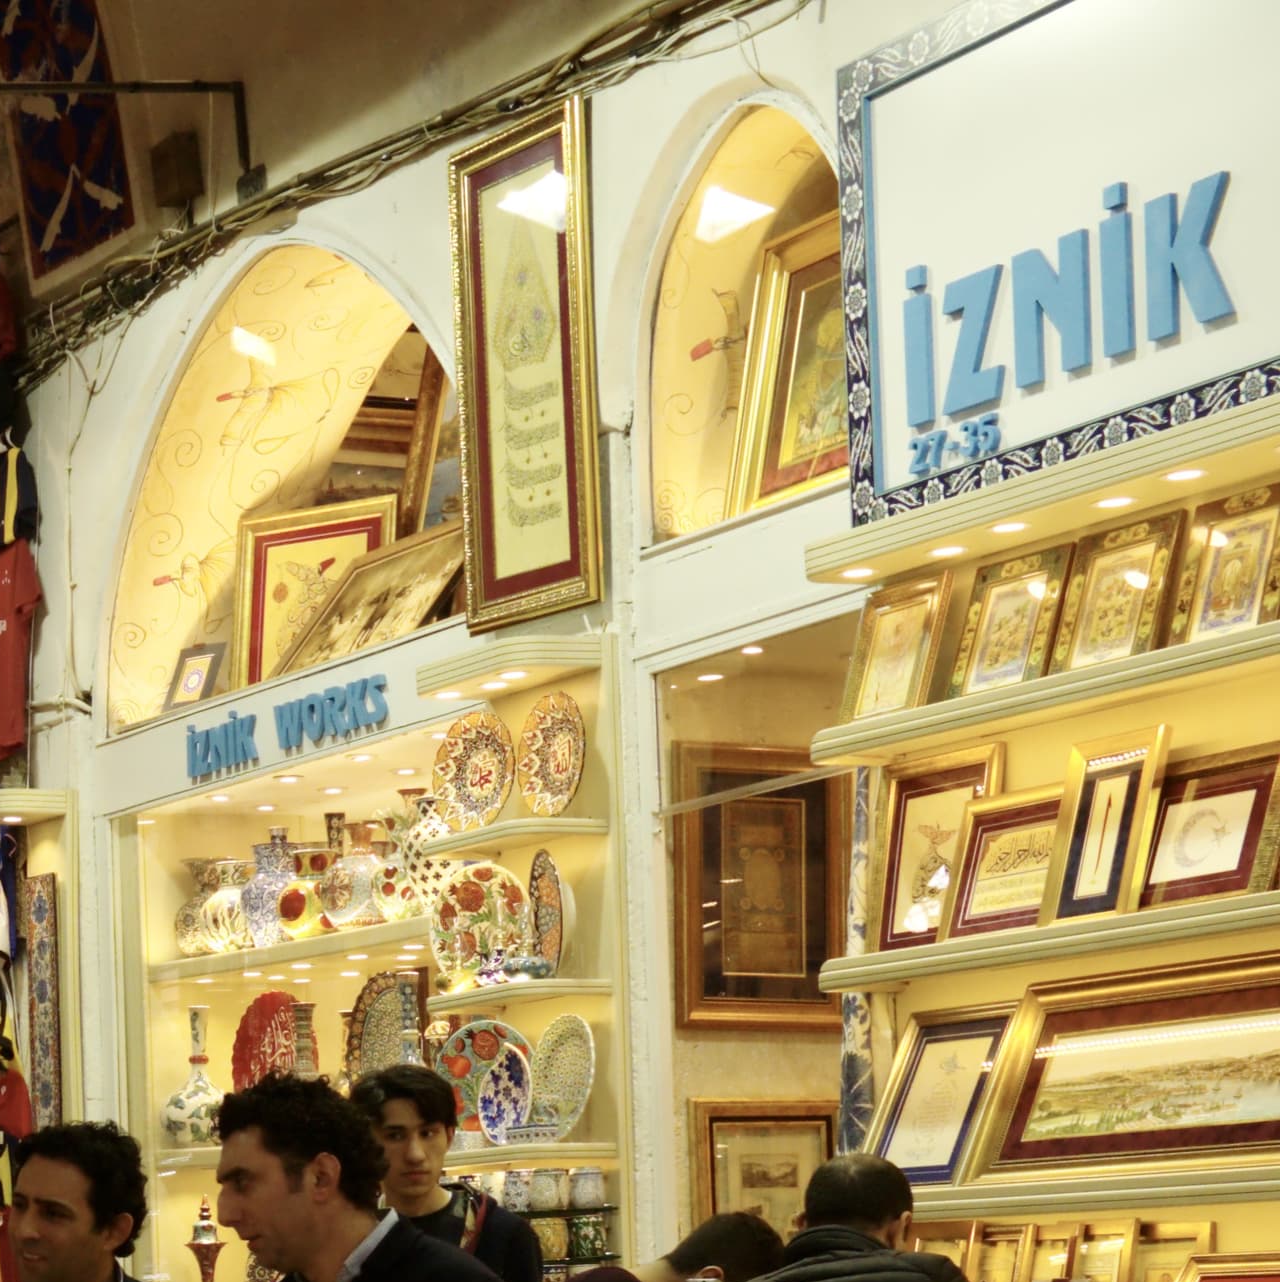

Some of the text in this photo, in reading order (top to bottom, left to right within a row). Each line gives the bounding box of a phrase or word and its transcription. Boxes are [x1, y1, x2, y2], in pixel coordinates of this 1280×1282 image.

[904, 171, 1237, 428] İZNİK
[909, 413, 1002, 475] 27-35
[186, 673, 388, 778] İZNİK WORKS
